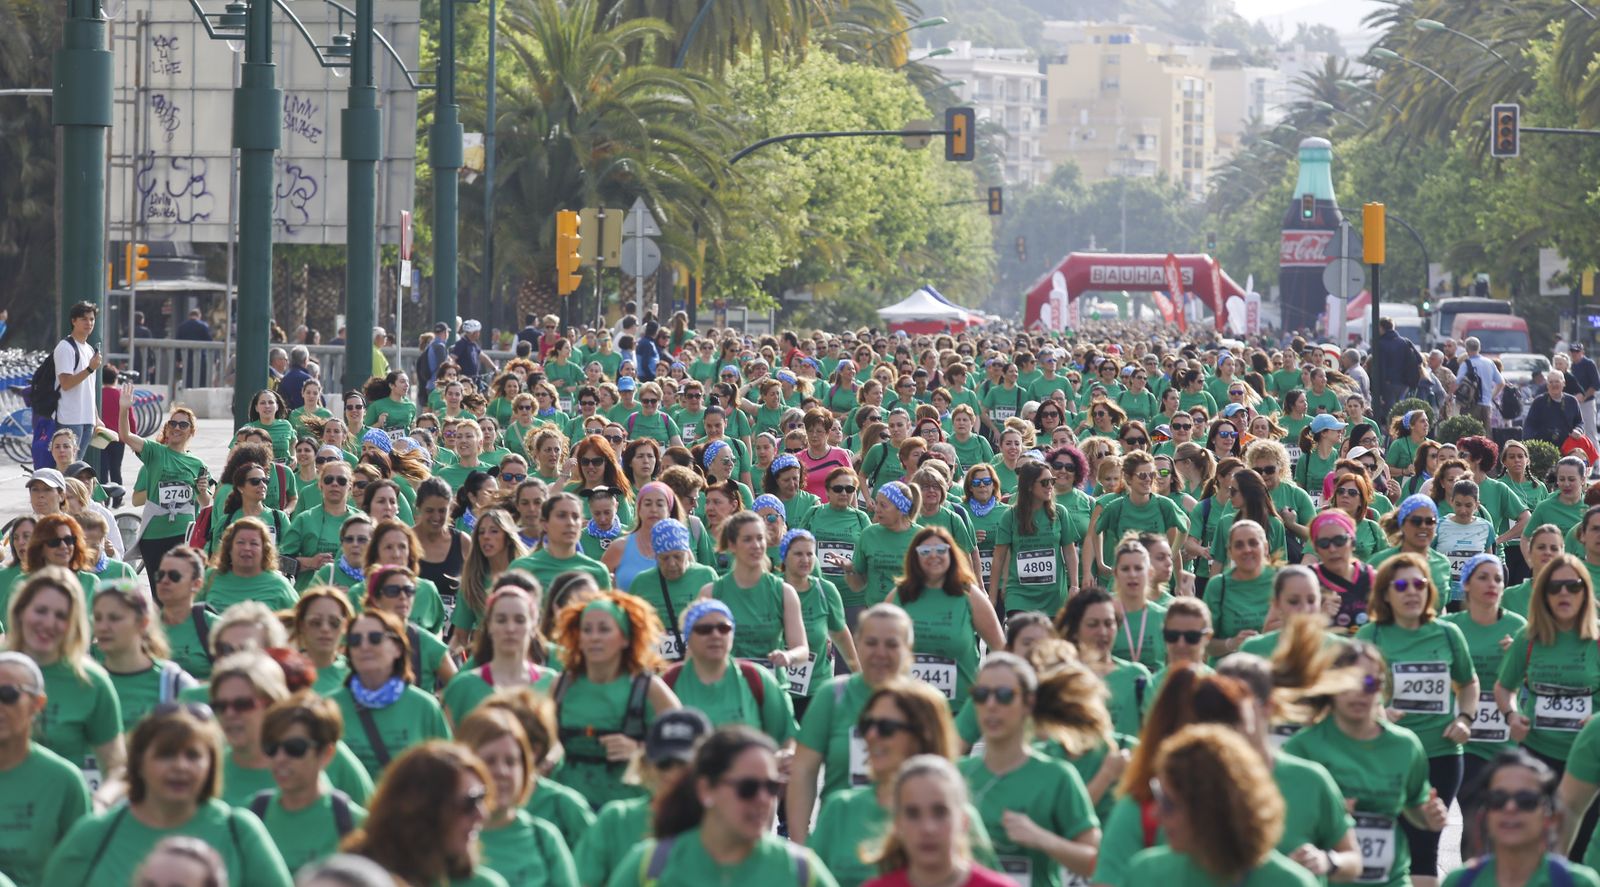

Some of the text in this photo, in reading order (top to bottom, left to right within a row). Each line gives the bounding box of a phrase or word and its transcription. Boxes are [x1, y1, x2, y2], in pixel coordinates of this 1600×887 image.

[1092, 266, 1192, 283] BAUHAS
[164, 489, 190, 500] 2740
[1023, 560, 1053, 573] 4809
[911, 669, 950, 684] 2441
[1401, 679, 1445, 695] 2038
[1542, 695, 1586, 713] 3633
